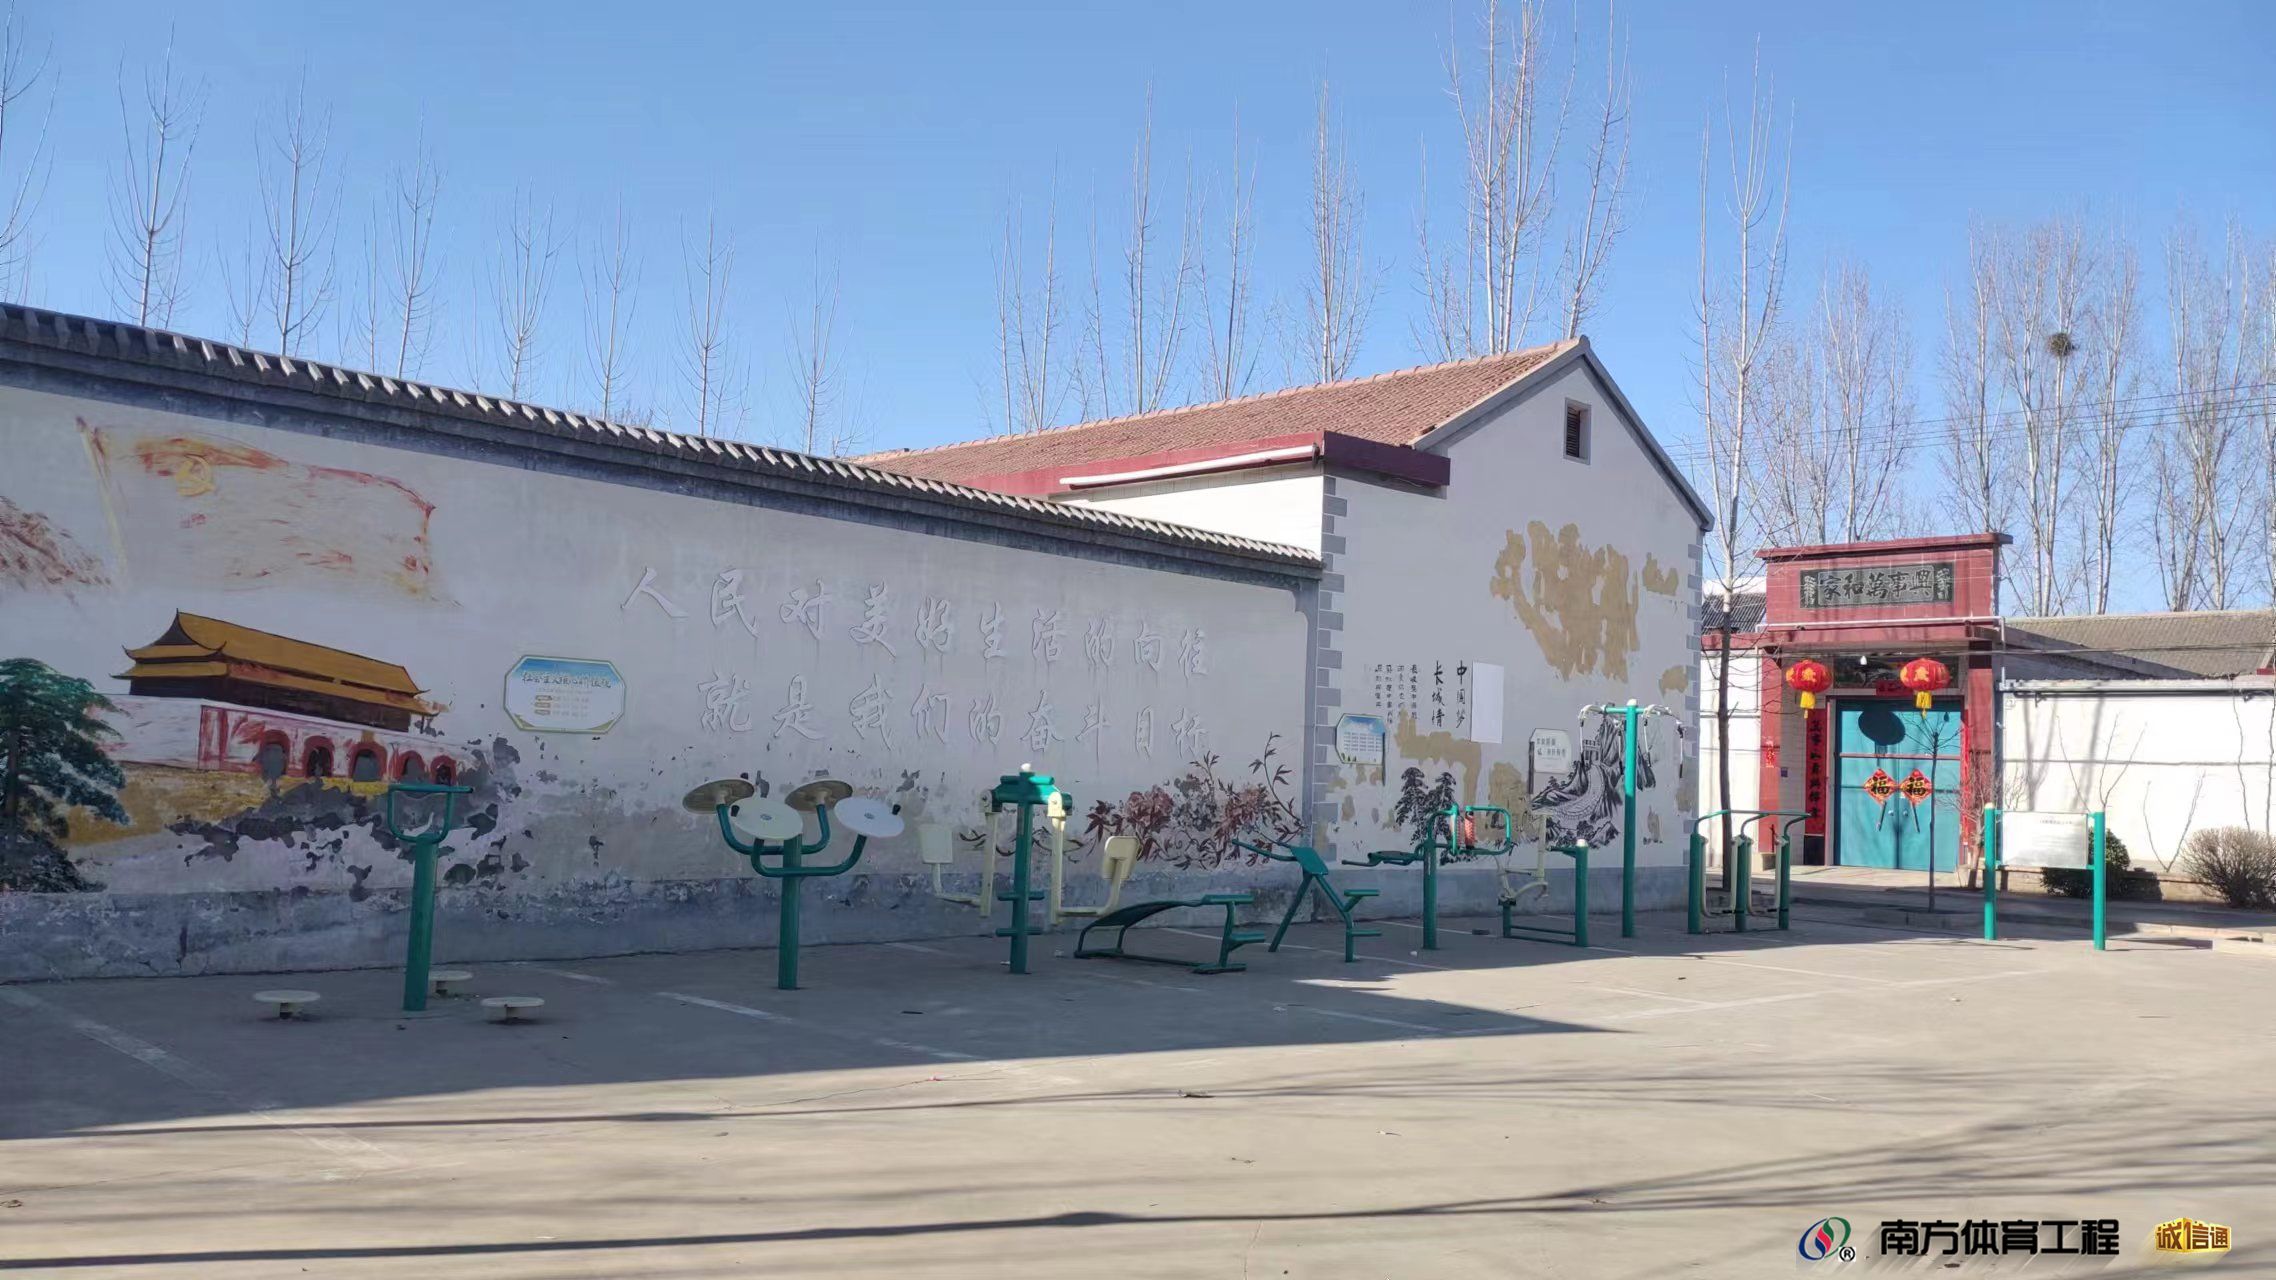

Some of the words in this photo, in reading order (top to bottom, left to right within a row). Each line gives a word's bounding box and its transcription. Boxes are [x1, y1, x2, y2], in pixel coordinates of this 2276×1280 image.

[620, 567, 1207, 679] 人民对美好生活的向往
[697, 672, 1207, 760] 就是我们的奋斗目标
[1871, 776, 1890, 794] 福
[1906, 776, 1926, 796] 福
